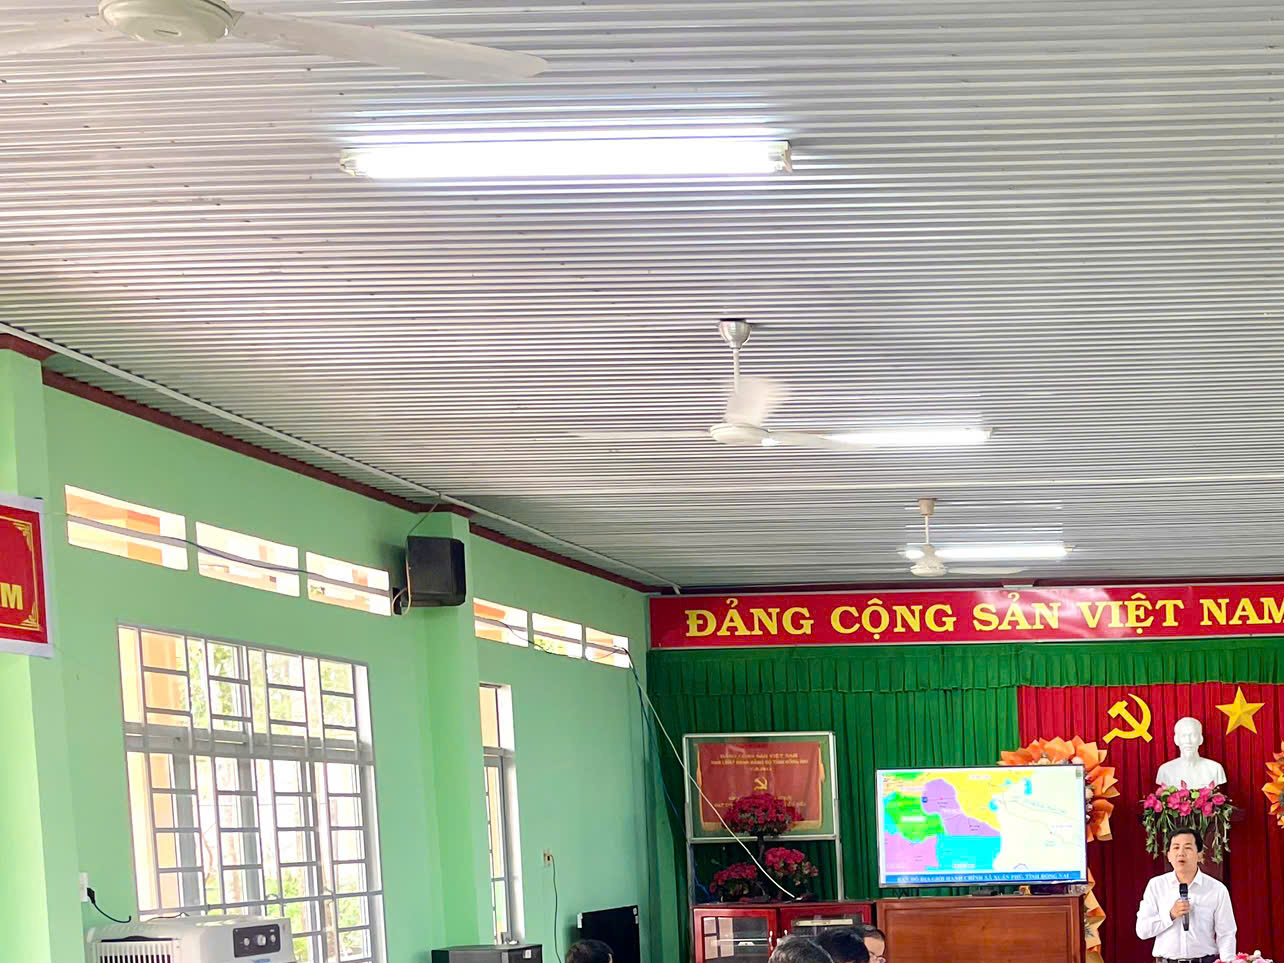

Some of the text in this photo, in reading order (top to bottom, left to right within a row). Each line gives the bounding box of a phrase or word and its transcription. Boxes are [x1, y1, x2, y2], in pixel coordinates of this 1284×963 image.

[685, 597, 814, 637] ĐẢNG
[830, 597, 957, 639] CỘNG
[972, 592, 1062, 631] SẢN
[1075, 592, 1185, 634] VIỆT
